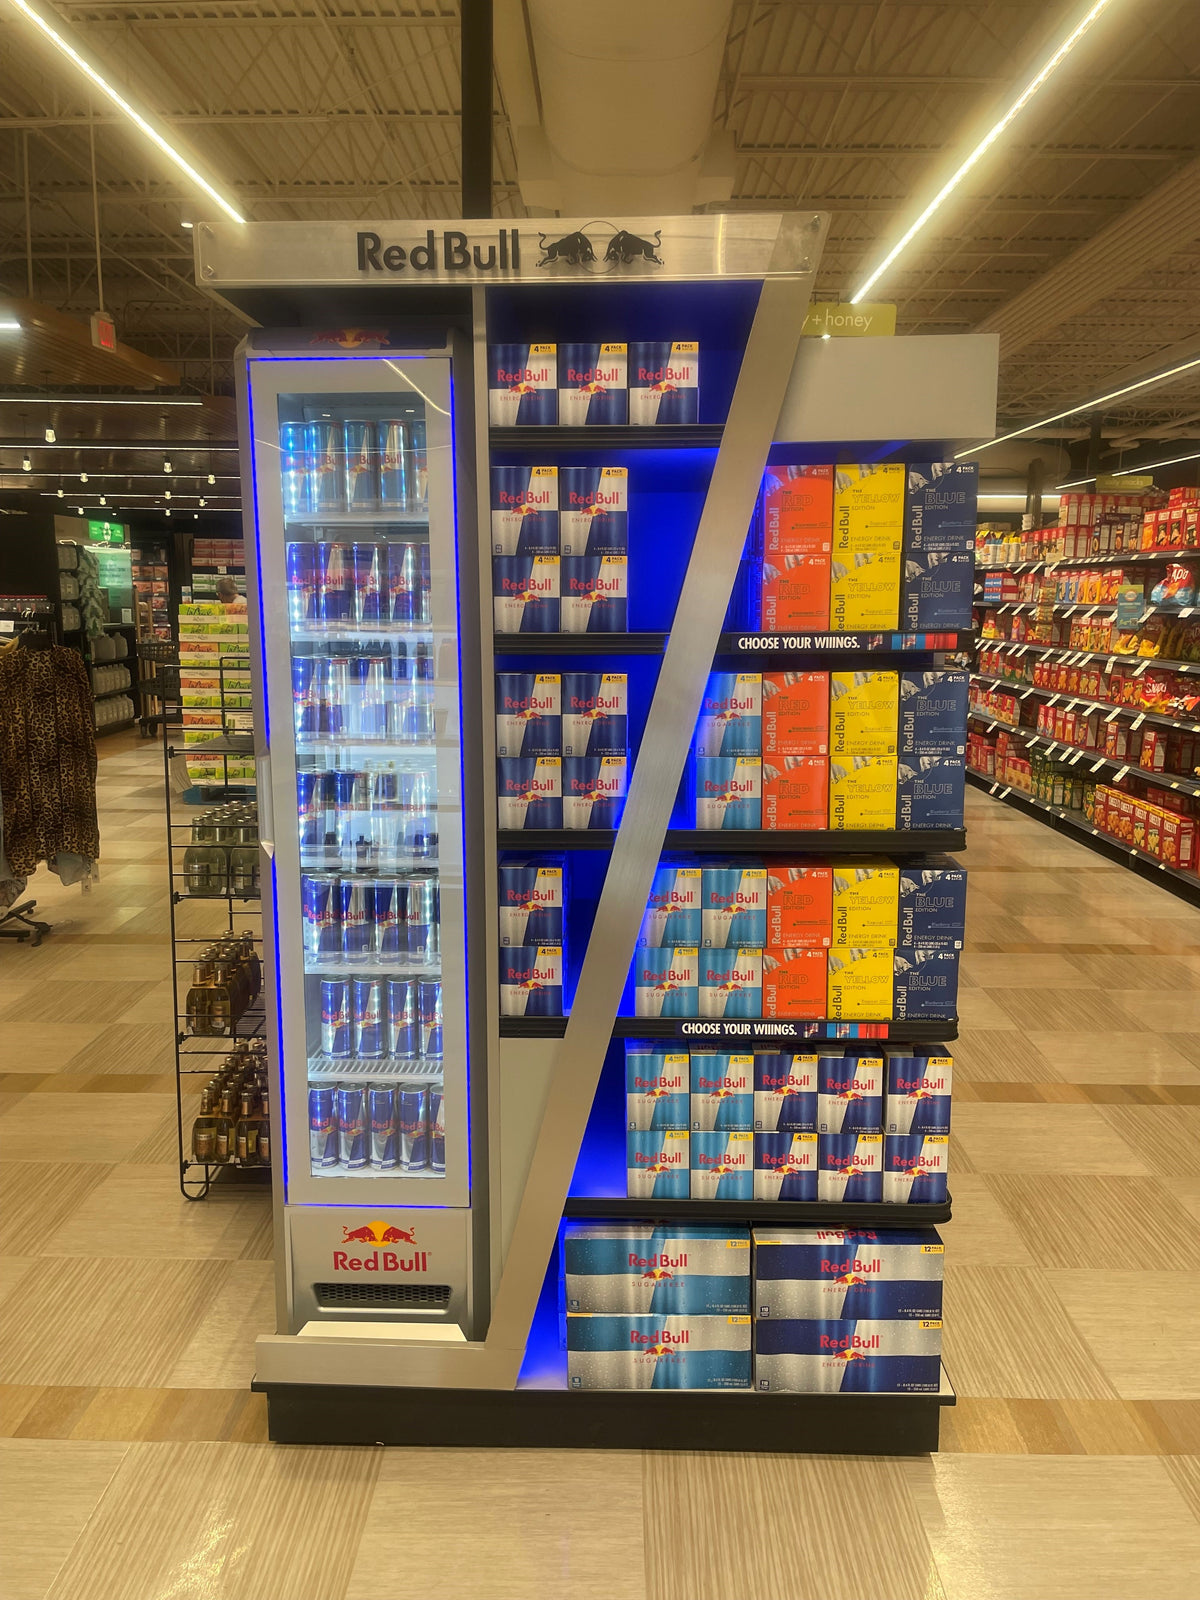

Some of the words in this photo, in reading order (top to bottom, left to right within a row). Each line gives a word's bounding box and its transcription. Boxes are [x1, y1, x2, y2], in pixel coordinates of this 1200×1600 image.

[357, 229, 435, 271] Red
[444, 229, 519, 270] Bull
[826, 309, 872, 332] honey
[912, 506, 922, 526] Bull
[912, 528, 922, 549] Red
[738, 637, 779, 649] CHOOSE
[782, 637, 811, 649] YOUR
[815, 637, 860, 648] WIIINGS.
[835, 712, 845, 731] Bull
[835, 732, 845, 752] Red
[772, 906, 781, 924] Bull
[903, 908, 913, 926] Bull
[772, 926, 781, 944] Red
[903, 928, 913, 946] Red
[682, 1023, 720, 1034] CHOOSE
[724, 1023, 750, 1035] YOUR
[754, 1024, 797, 1035] WIIINGS.
[333, 1251, 378, 1271] Red
[383, 1252, 427, 1271] Bull
[629, 1254, 657, 1267] Red
[660, 1254, 687, 1267] Bull
[821, 1259, 850, 1272] Red
[852, 1260, 880, 1272] Bull
[630, 1331, 659, 1344] Red
[662, 1331, 689, 1343] Bull
[820, 1335, 849, 1348] Red
[852, 1336, 879, 1348] Bull
